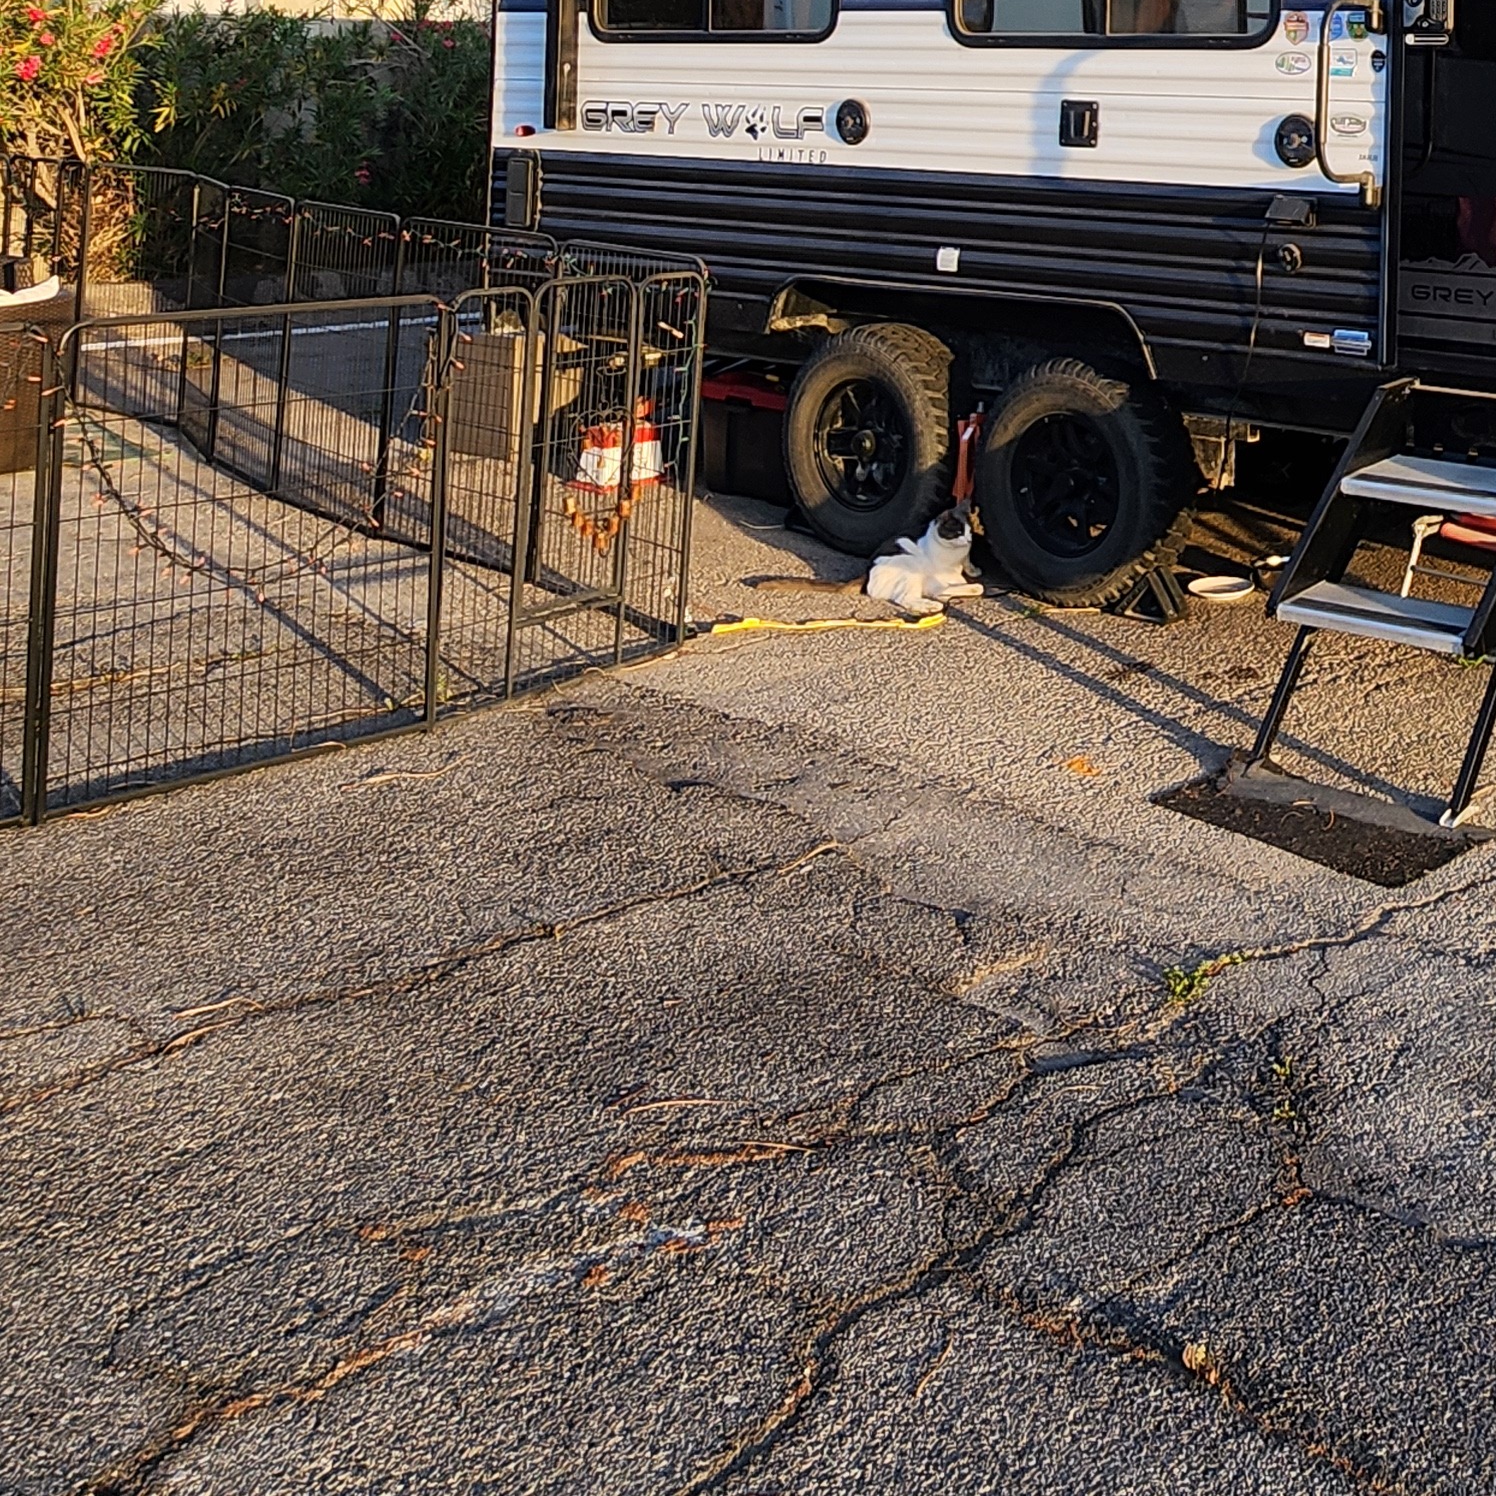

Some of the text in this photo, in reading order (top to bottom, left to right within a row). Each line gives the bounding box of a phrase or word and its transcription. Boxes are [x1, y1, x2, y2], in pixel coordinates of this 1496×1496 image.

[581, 100, 690, 135] GREY
[758, 147, 828, 163] LIMITED
[1411, 284, 1494, 306] GREY
